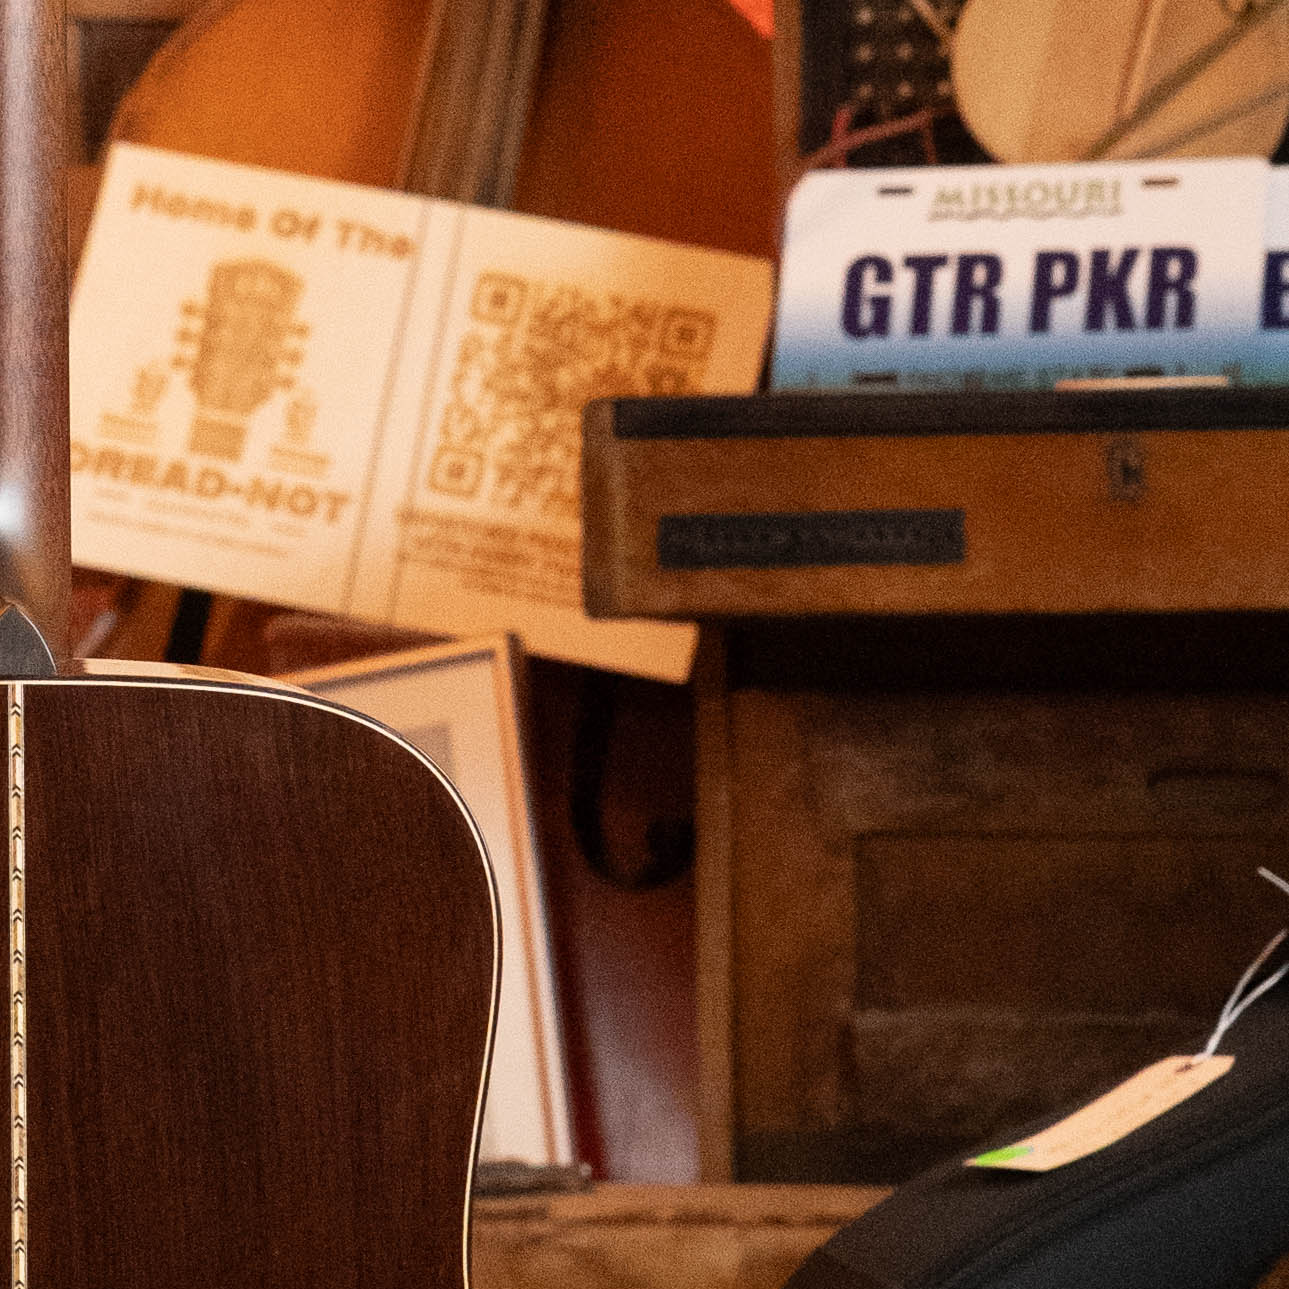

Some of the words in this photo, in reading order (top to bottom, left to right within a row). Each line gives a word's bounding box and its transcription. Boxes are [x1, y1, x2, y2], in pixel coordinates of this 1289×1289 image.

[129, 182, 258, 235] Home
[270, 207, 321, 244] Of
[334, 218, 416, 260] The
[930, 177, 1125, 213] MISSOURI
[841, 251, 1004, 340] GTR
[1027, 246, 1199, 334] PKR
